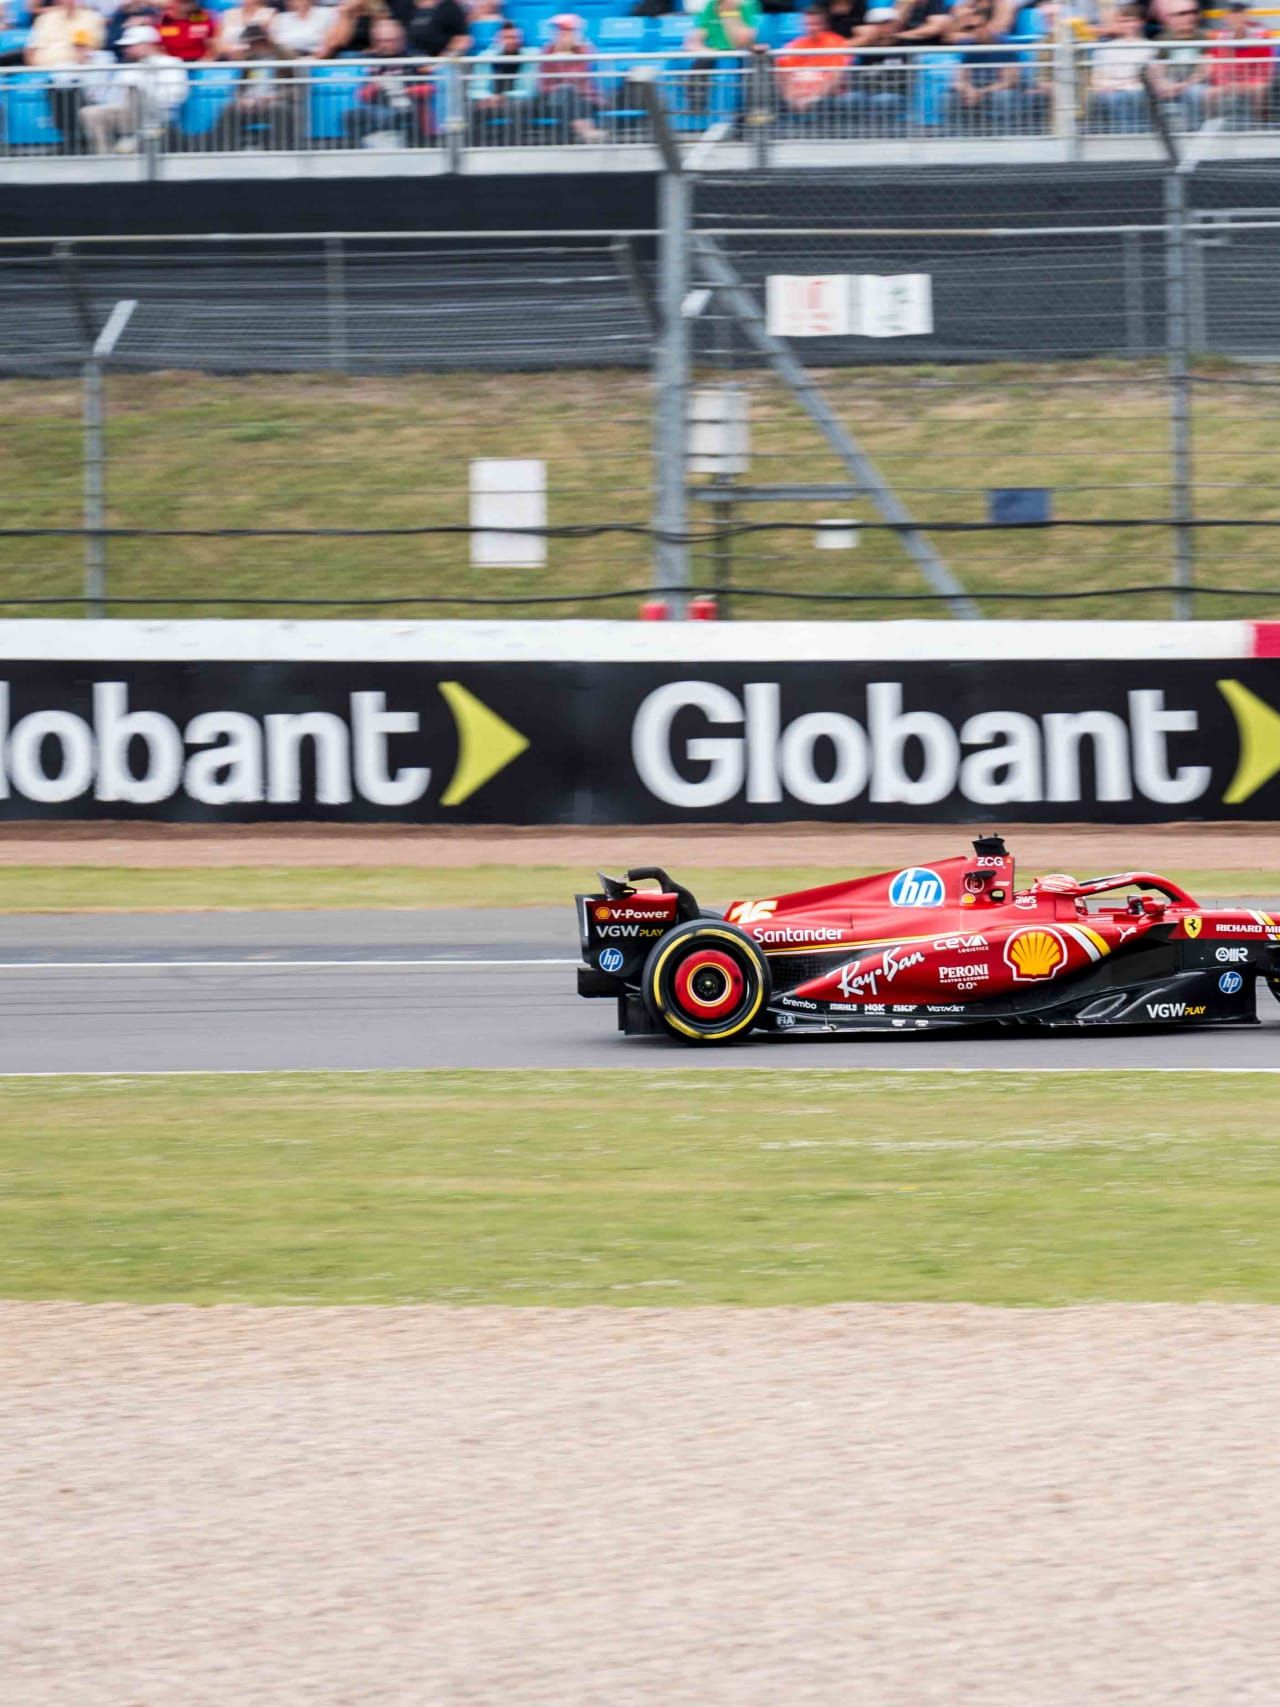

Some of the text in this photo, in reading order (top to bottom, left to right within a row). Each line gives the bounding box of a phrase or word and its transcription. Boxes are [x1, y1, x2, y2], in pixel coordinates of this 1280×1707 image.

[0, 681, 431, 805] obant
[632, 681, 1211, 807] Globant
[897, 869, 939, 906] hp
[611, 908, 670, 919] V-Power
[595, 925, 640, 938] VGW
[753, 928, 844, 943] Santander
[1215, 923, 1262, 933] RICHARD
[603, 949, 621, 971] hp
[938, 963, 989, 979] PERONI
[1222, 971, 1239, 993] hp
[782, 996, 817, 1010] brembo
[1146, 1002, 1186, 1018] VGW
